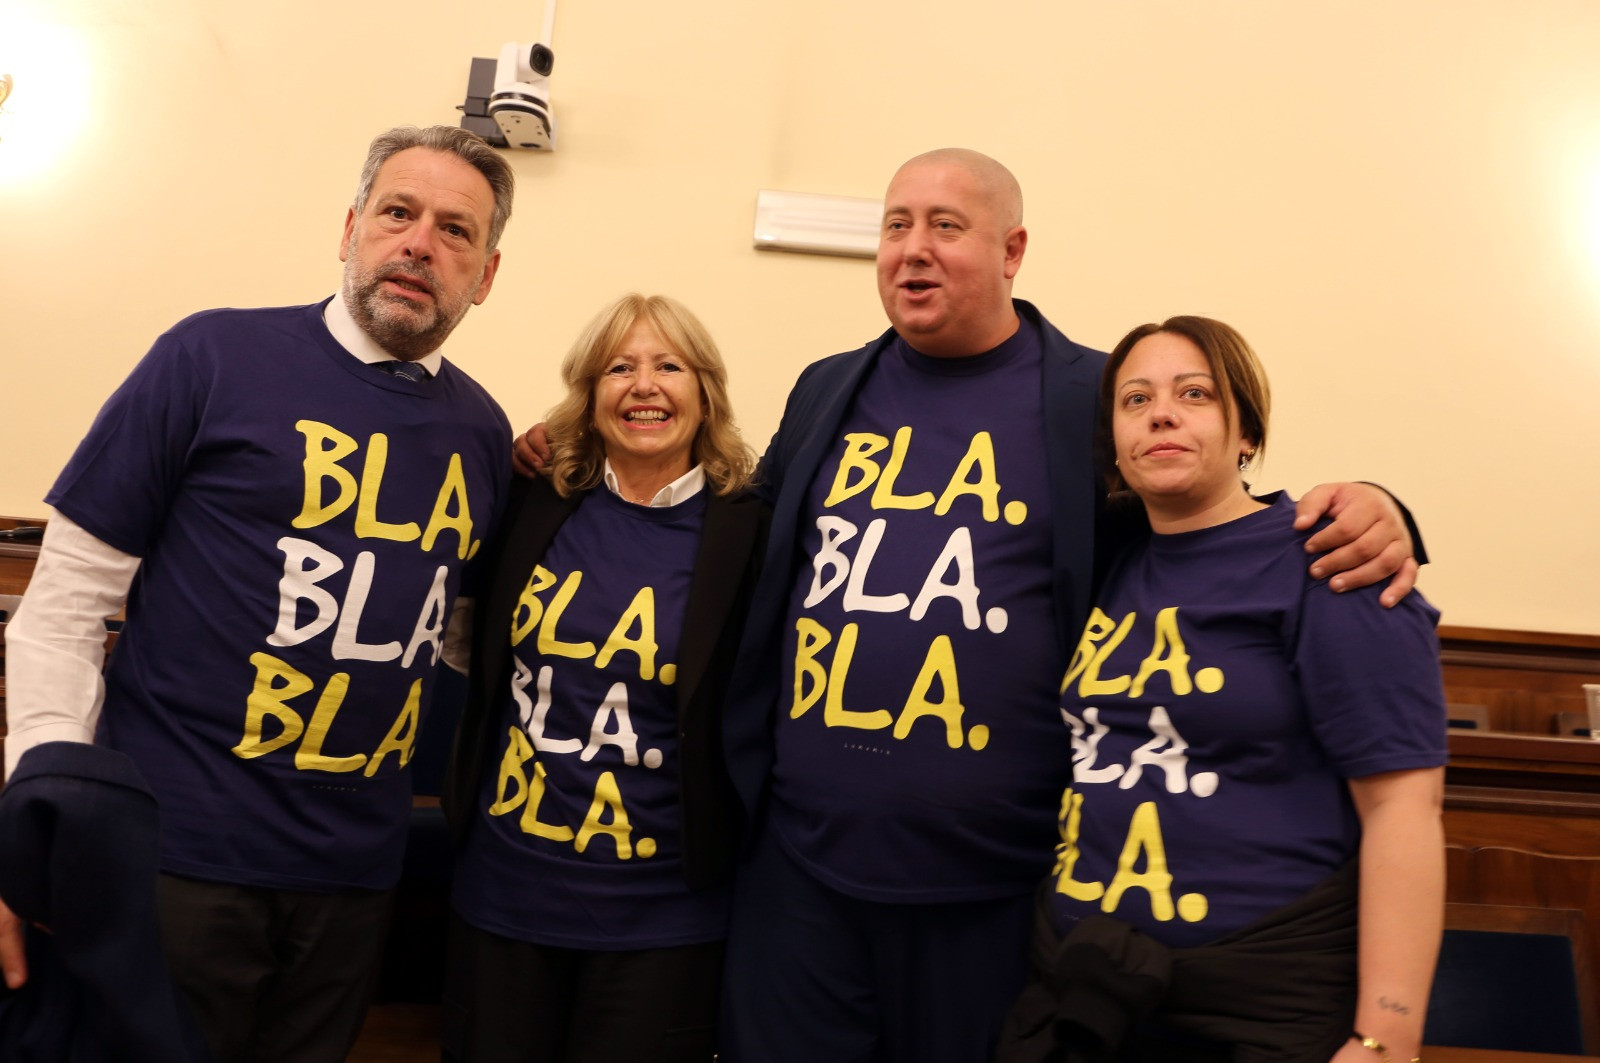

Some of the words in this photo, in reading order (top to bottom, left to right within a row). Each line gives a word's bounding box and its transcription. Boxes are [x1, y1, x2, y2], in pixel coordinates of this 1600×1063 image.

[824, 426, 1028, 525] BLA.
[511, 564, 677, 685] BLA.
[803, 516, 1008, 633] BLA.
[790, 617, 990, 751] BLA.
[1060, 607, 1225, 698] BLA.
[231, 652, 422, 777] BLA
[489, 726, 657, 860] BLA.
